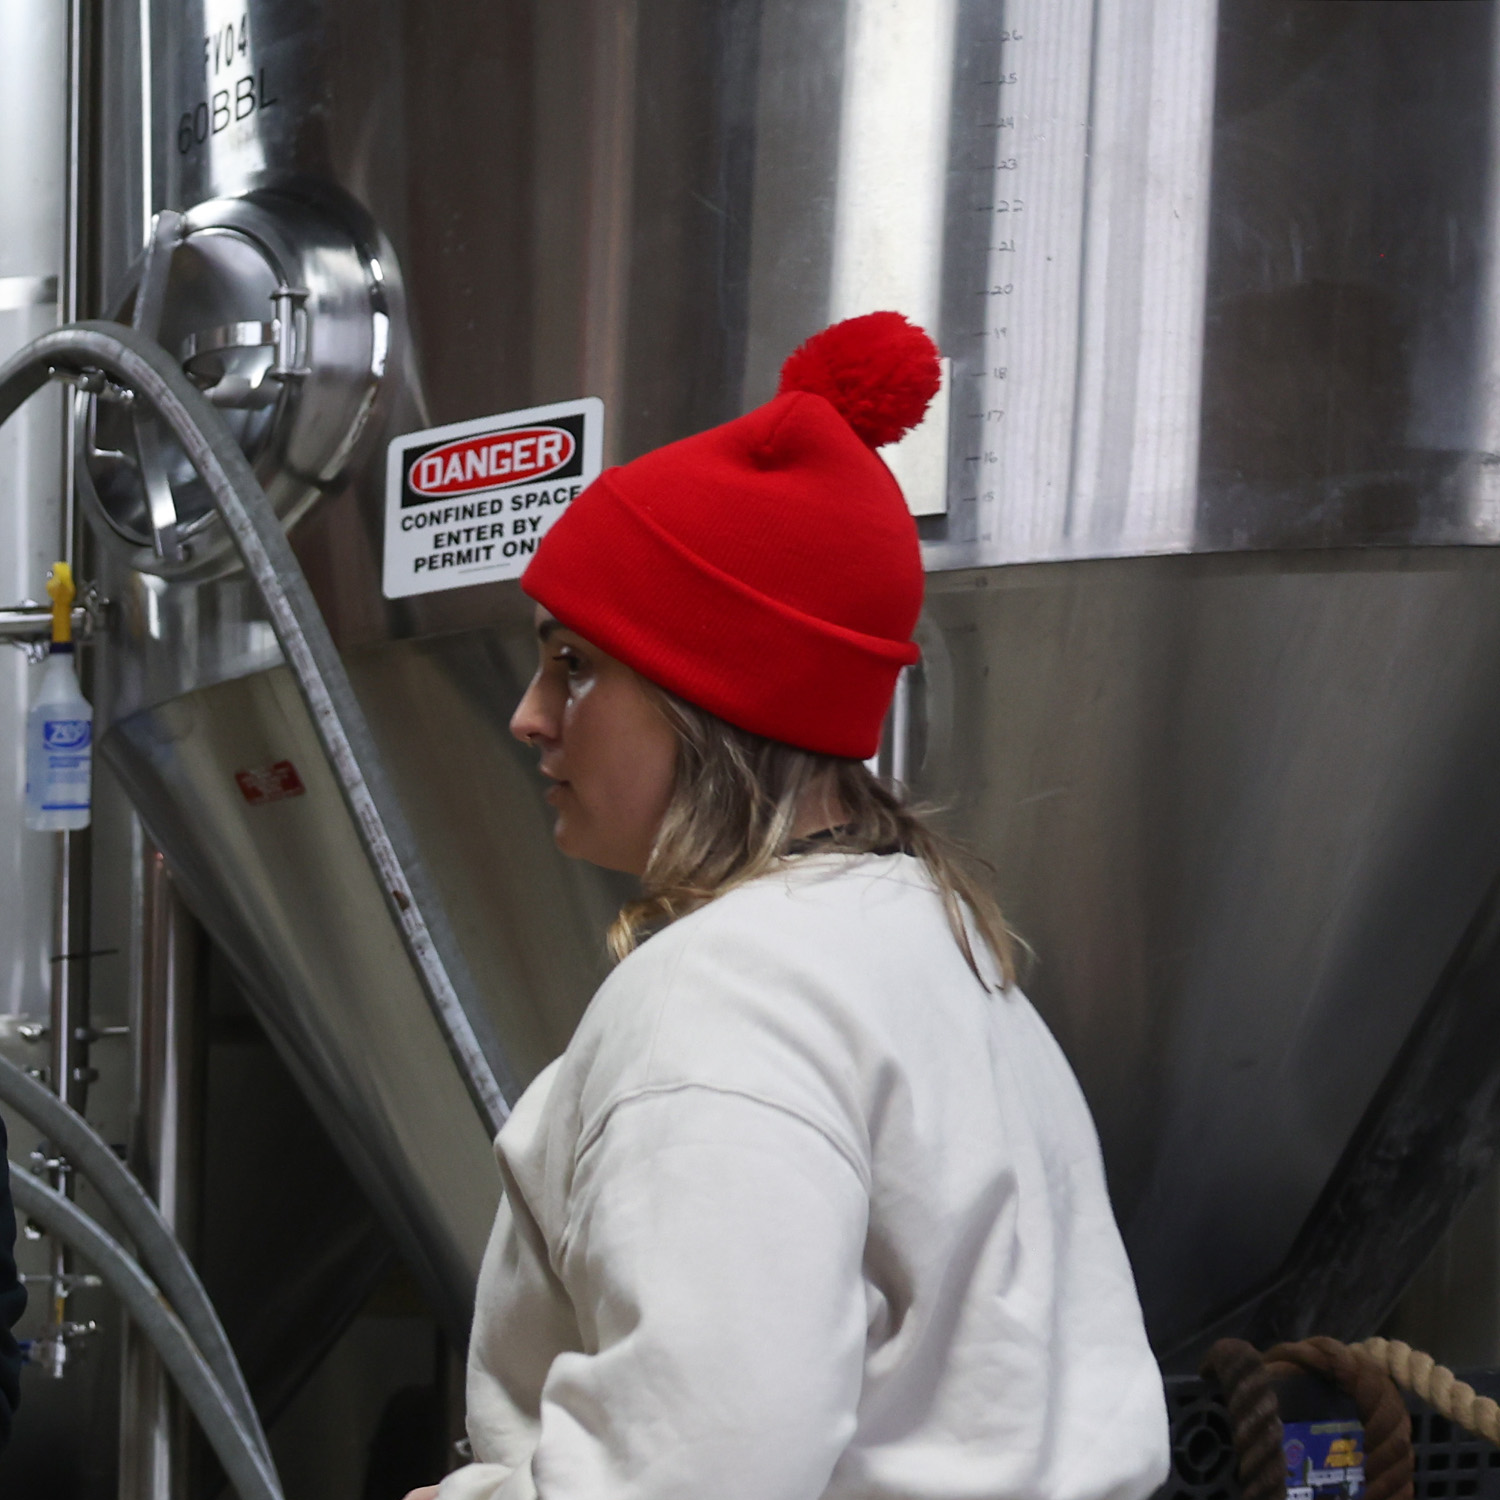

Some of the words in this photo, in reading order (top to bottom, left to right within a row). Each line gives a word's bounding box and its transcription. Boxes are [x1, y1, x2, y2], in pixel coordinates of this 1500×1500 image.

[177, 67, 279, 155] 60BBL
[997, 158, 1018, 170] 23
[997, 199, 1024, 213] 22
[998, 239, 1016, 252] 21
[990, 283, 1013, 295] 20
[419, 432, 564, 490] DANGER
[400, 498, 503, 532] CONFINED
[510, 484, 583, 512] SPACE
[433, 522, 504, 549] ENTER
[512, 515, 542, 535] BY
[413, 544, 495, 574] PERMIT
[502, 537, 543, 558] ON
